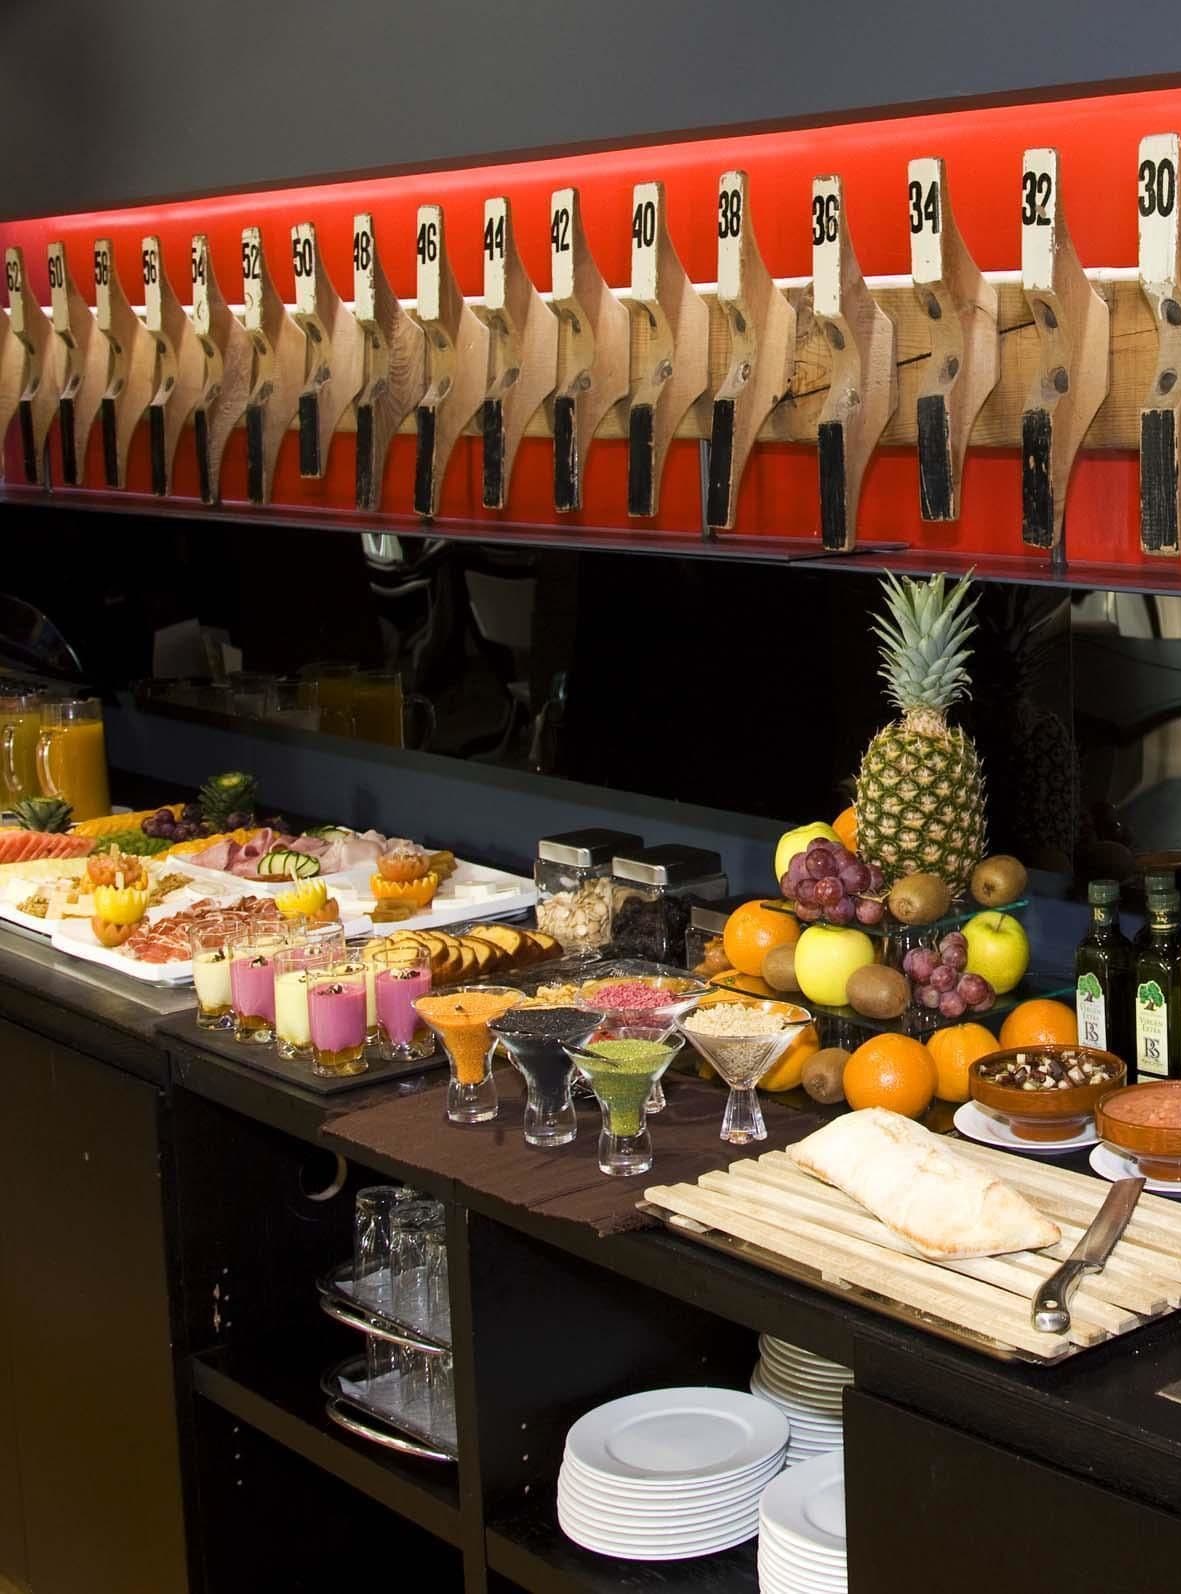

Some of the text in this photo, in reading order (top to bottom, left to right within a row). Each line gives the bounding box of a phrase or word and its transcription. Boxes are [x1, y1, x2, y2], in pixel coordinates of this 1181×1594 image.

[909, 181, 940, 233] 34
[1022, 172, 1053, 226] 32
[1138, 159, 1176, 218] 30
[551, 208, 571, 252] 42
[632, 202, 656, 248] 40
[718, 190, 742, 238] 38
[812, 195, 839, 245] 36
[293, 237, 313, 277] 50
[353, 231, 371, 272] 48
[417, 223, 437, 265] 46
[484, 216, 504, 260] 44
[48, 257, 64, 288] 60
[142, 250, 157, 285] 56
[191, 248, 206, 286] 54
[243, 243, 260, 279] 52
